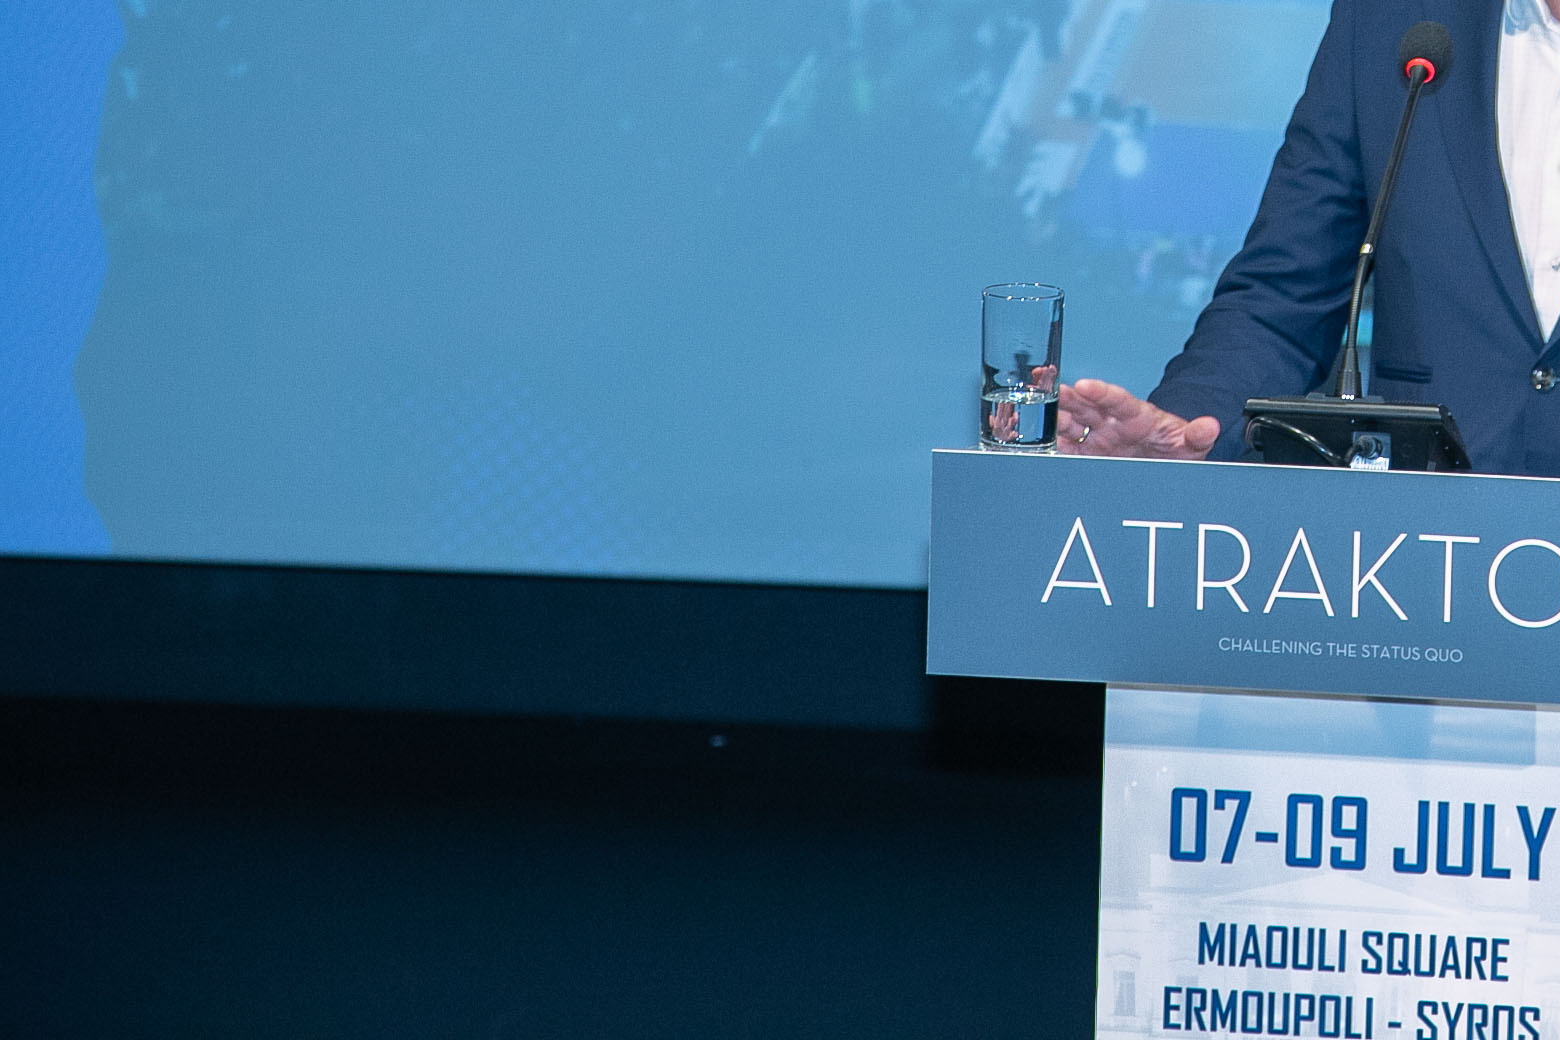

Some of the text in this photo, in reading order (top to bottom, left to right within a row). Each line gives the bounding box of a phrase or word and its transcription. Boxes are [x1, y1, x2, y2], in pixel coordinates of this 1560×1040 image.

[1218, 637, 1464, 663] CHALLENING THE STATUS QUO
[1168, 787, 1557, 882] 07-09 JULY
[1197, 921, 1511, 983] MIAOULI SQUARE
[1162, 985, 1375, 1040] ERMOUPOLI
[1416, 1000, 1541, 1040] SYROS
